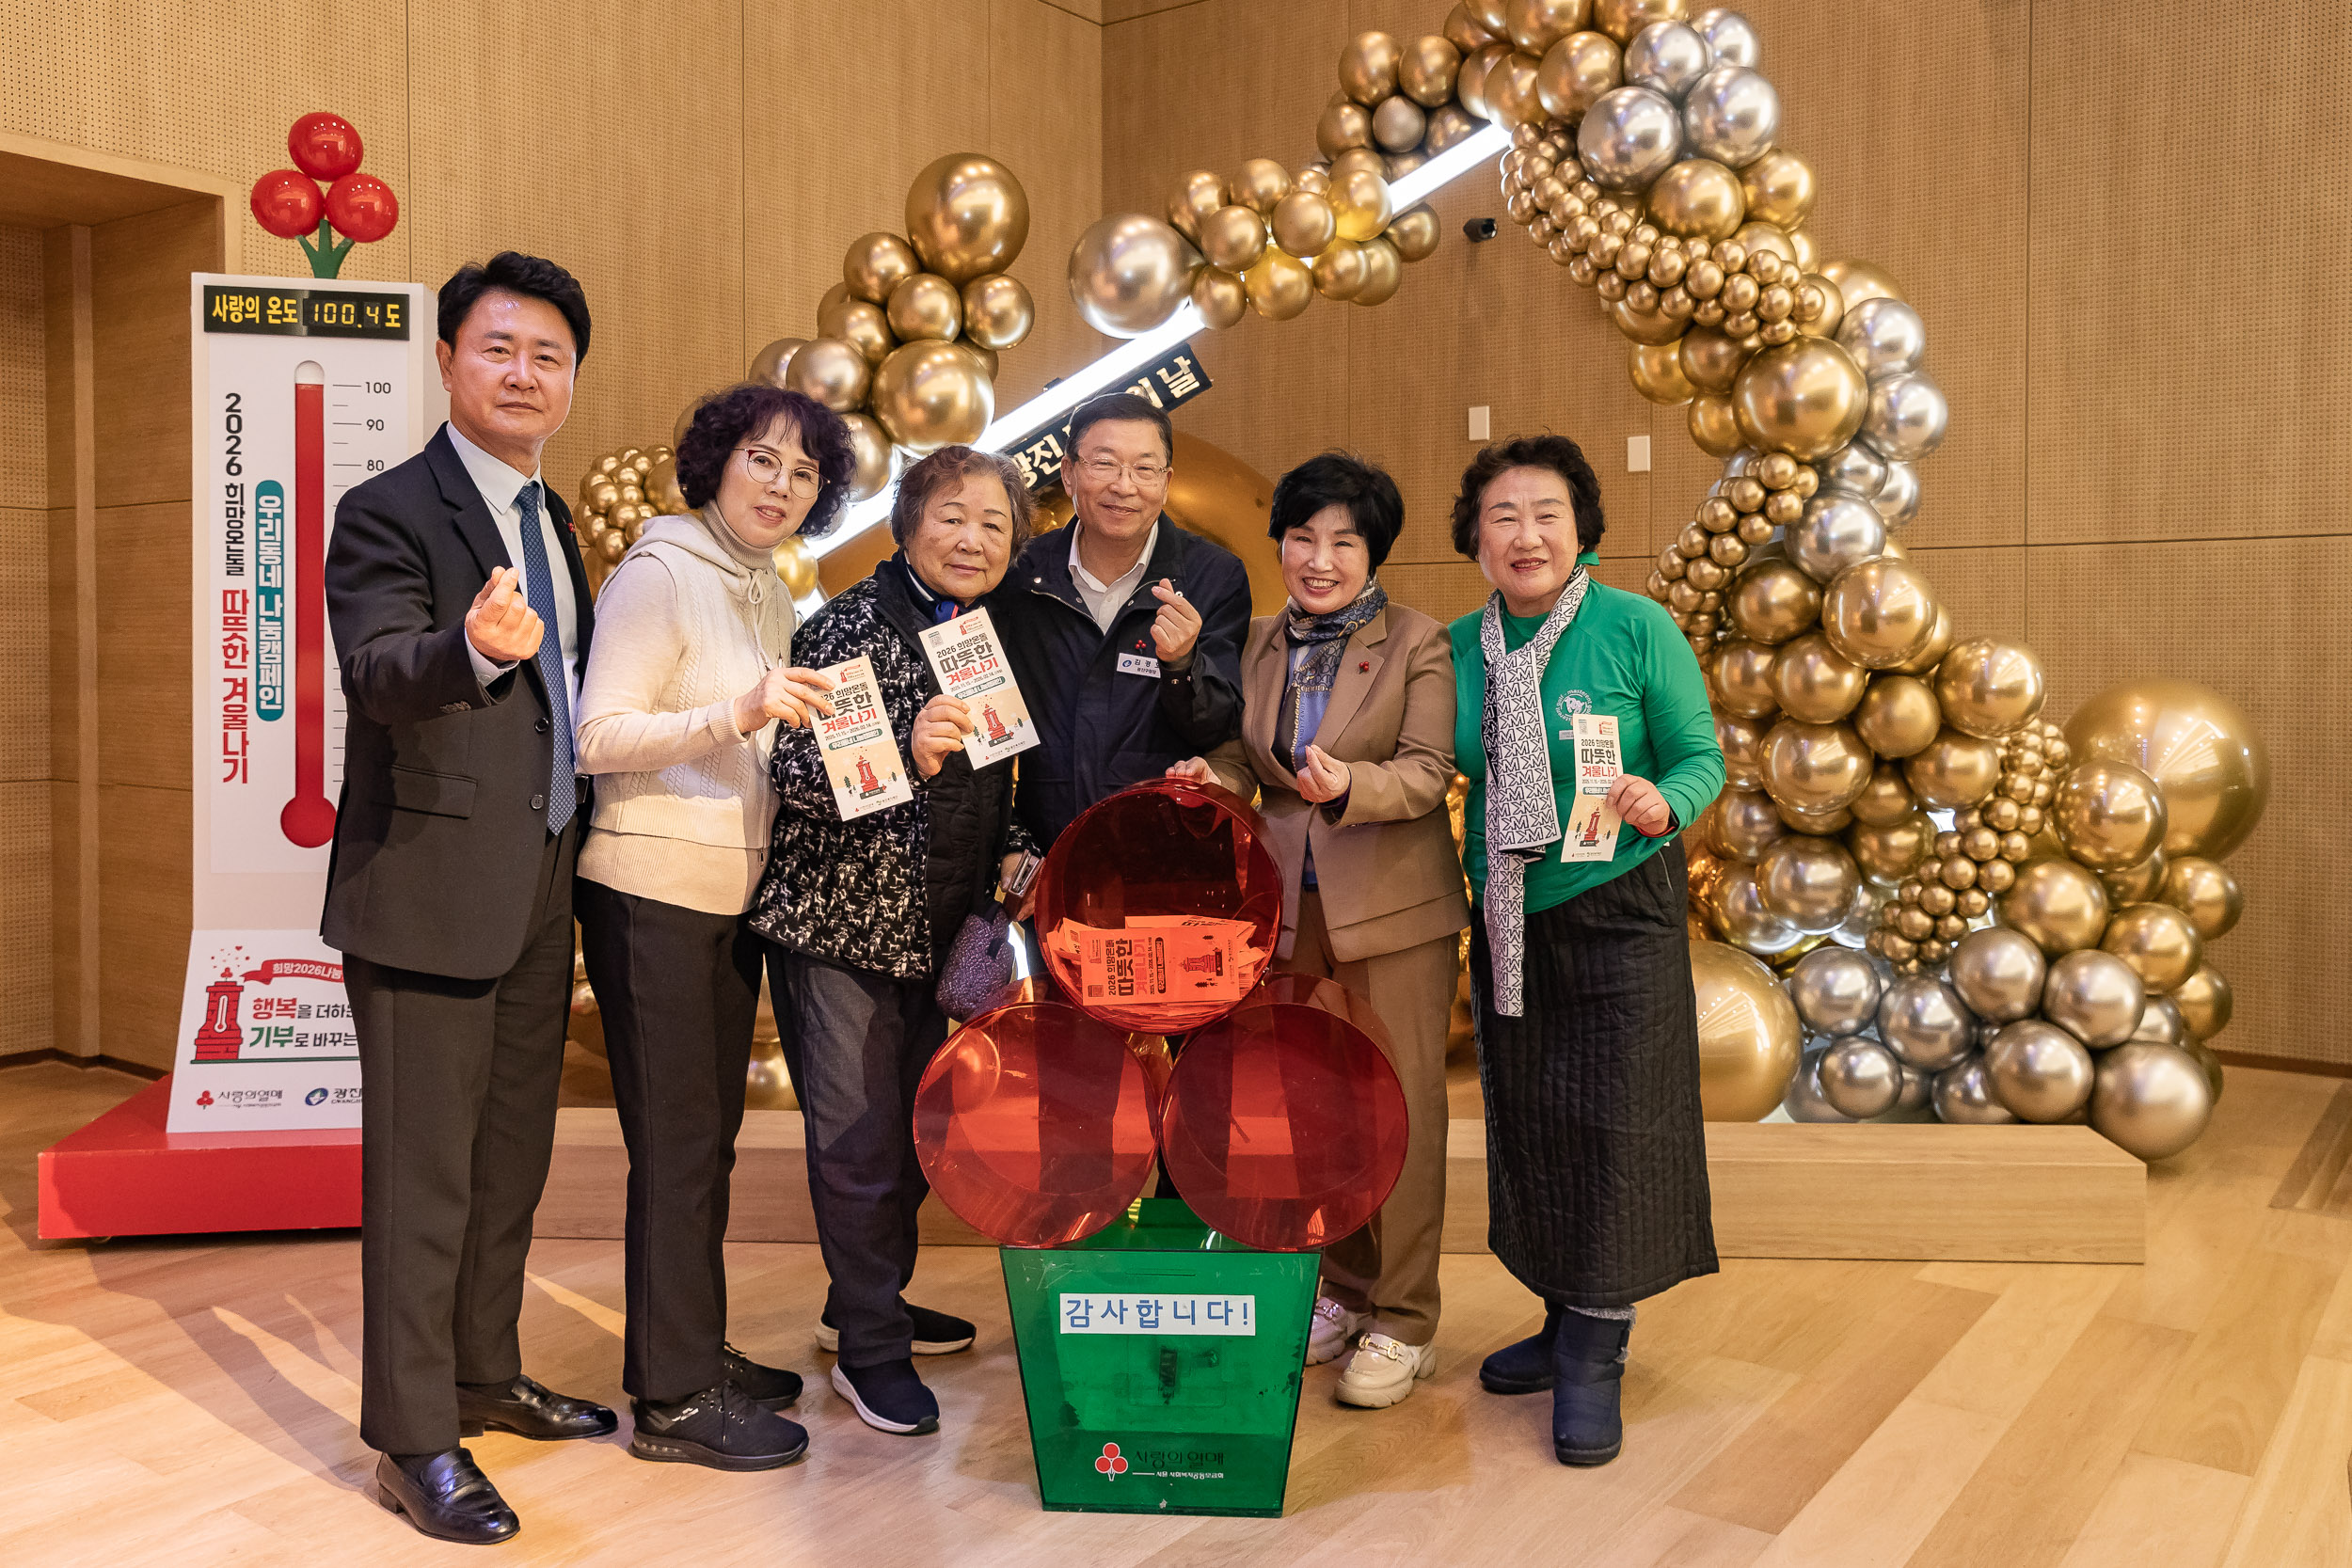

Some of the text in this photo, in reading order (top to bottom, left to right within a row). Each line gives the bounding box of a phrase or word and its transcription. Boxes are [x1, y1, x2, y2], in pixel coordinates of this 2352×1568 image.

[212, 293, 261, 324] 사랑의
[266, 296, 298, 325] 온도
[365, 381, 391, 394] 100
[1155, 355, 1200, 400] 날
[366, 420, 385, 432] 90
[366, 460, 385, 472] 80
[221, 392, 249, 784] 2026 희망온돌 따뜻한 겨울나기
[258, 494, 283, 711] 우리동네 나눔캠페인
[936, 645, 957, 658] 2026
[940, 641, 993, 673] 따뜻한
[946, 657, 998, 685] 겨울나기
[835, 682, 868, 699] 희망온돌
[821, 707, 877, 734] 겨울나기
[1581, 748, 1616, 765] 따뜻한
[1582, 766, 1618, 777] 겨울나기
[1116, 938, 1135, 996] 따뜻한
[1134, 939, 1148, 995] 겨울나기
[253, 997, 311, 1020] 행복을
[249, 1026, 358, 1048] 기부로 바꾸는
[1065, 1298, 1248, 1329] 감사합니다!
